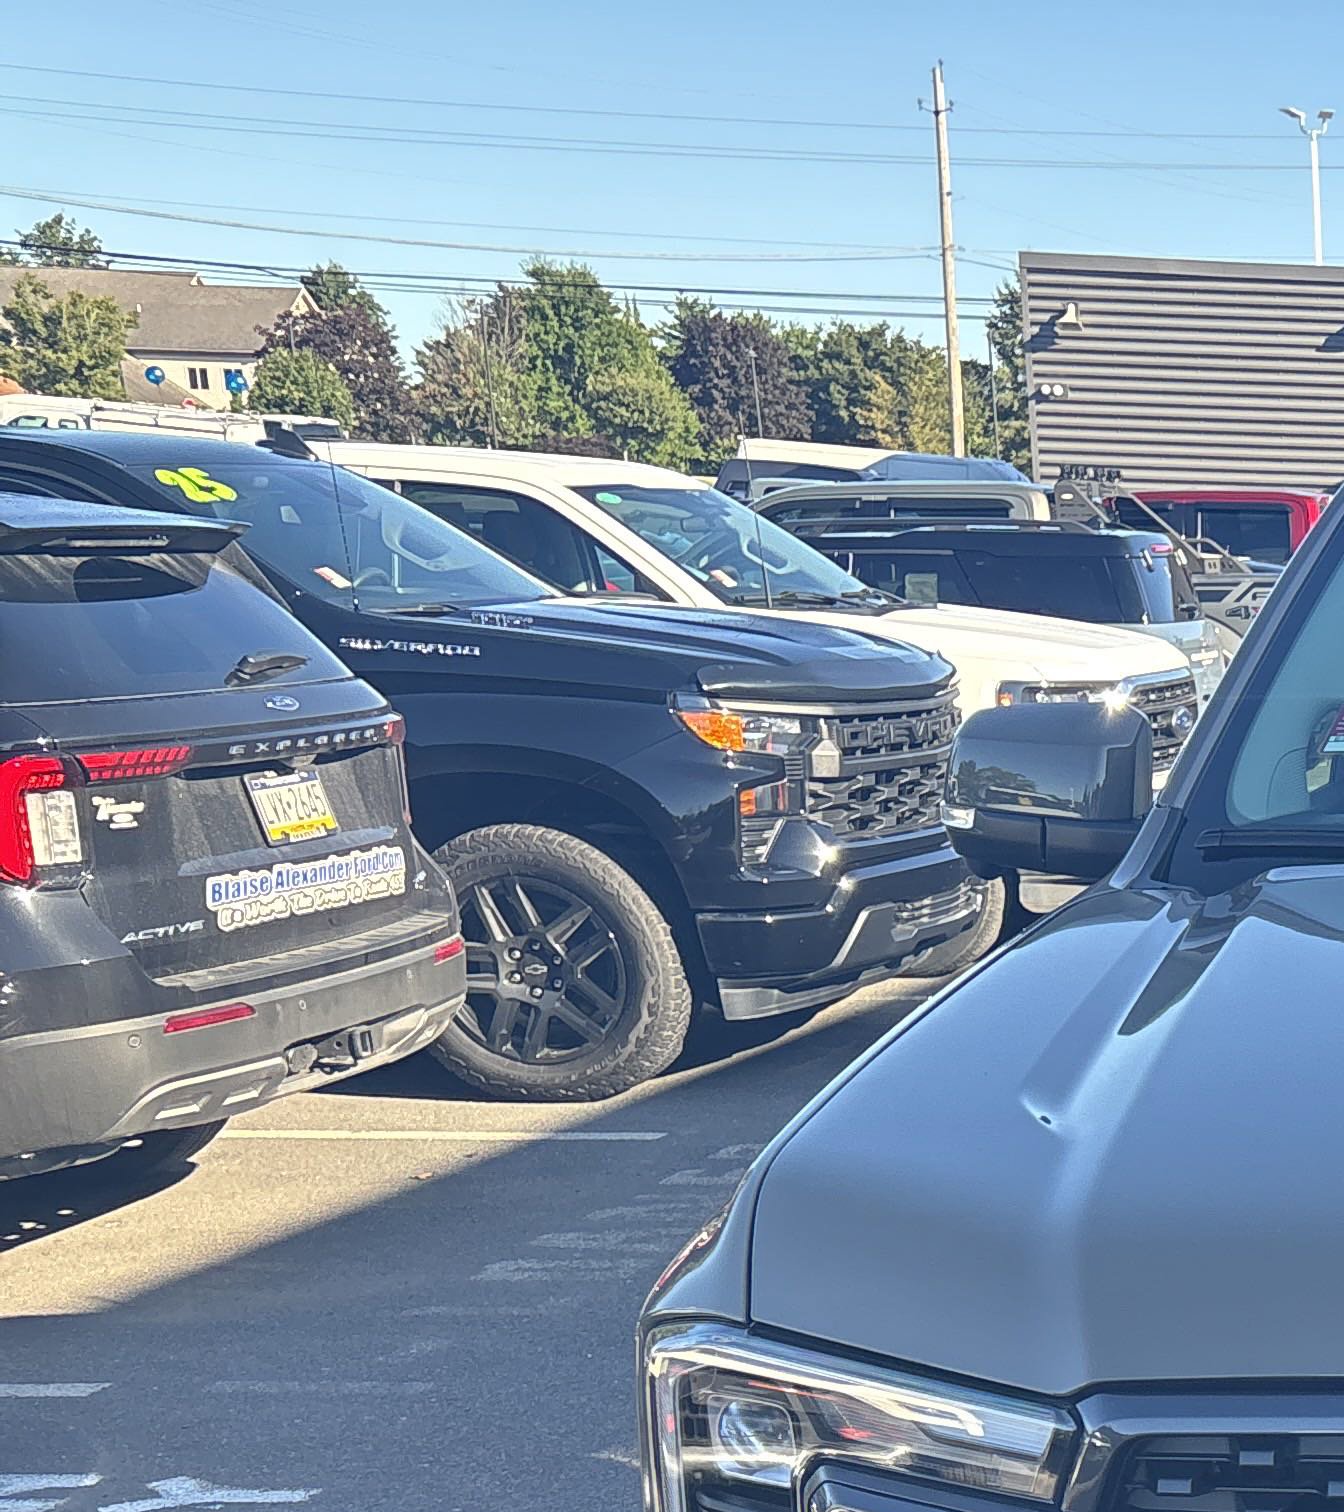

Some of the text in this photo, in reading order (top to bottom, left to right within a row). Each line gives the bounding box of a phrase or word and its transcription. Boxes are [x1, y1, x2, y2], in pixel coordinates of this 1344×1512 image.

[339, 637, 481, 656] SILVERADO
[228, 728, 376, 755] EXPLORER
[211, 875, 270, 904] Blaise
[275, 860, 352, 890] Alexander
[120, 919, 206, 944] ACTIVE
